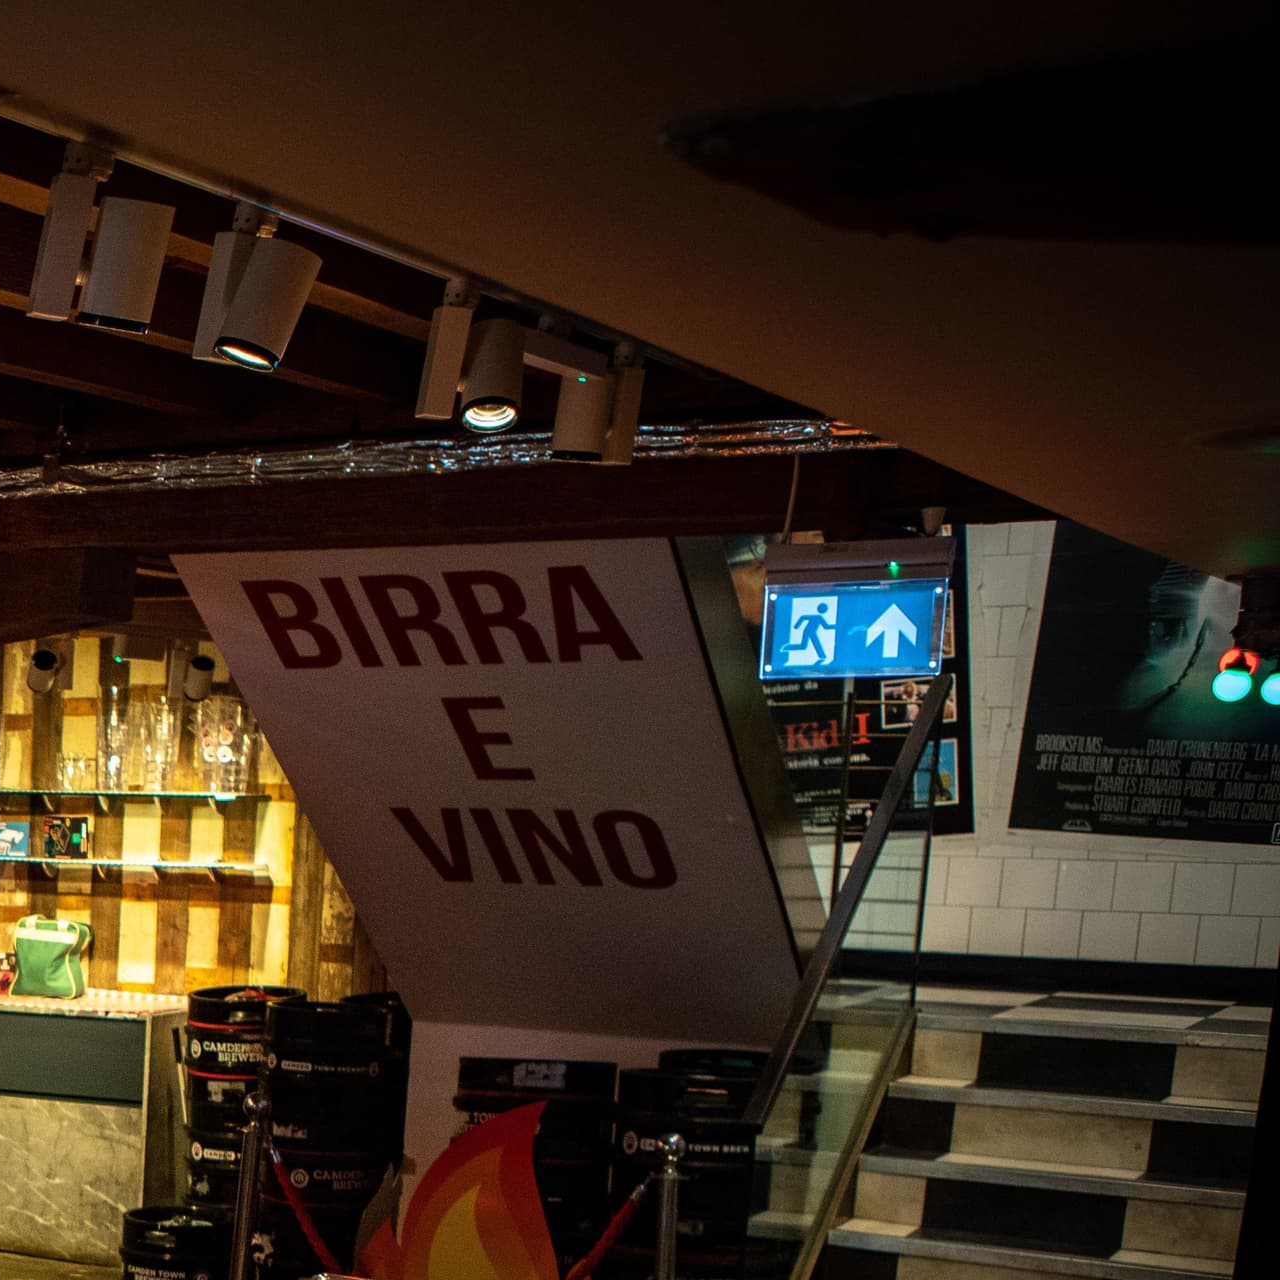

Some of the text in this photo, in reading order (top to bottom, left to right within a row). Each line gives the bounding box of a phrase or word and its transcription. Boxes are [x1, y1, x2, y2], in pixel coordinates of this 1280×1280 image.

[240, 564, 644, 670] BIRRA
[440, 696, 536, 781] E
[785, 719, 841, 752] Kid
[389, 806, 678, 890] VINO
[688, 1143, 720, 1153] TOWN
[127, 1264, 186, 1280] CAMDEN TOWN
